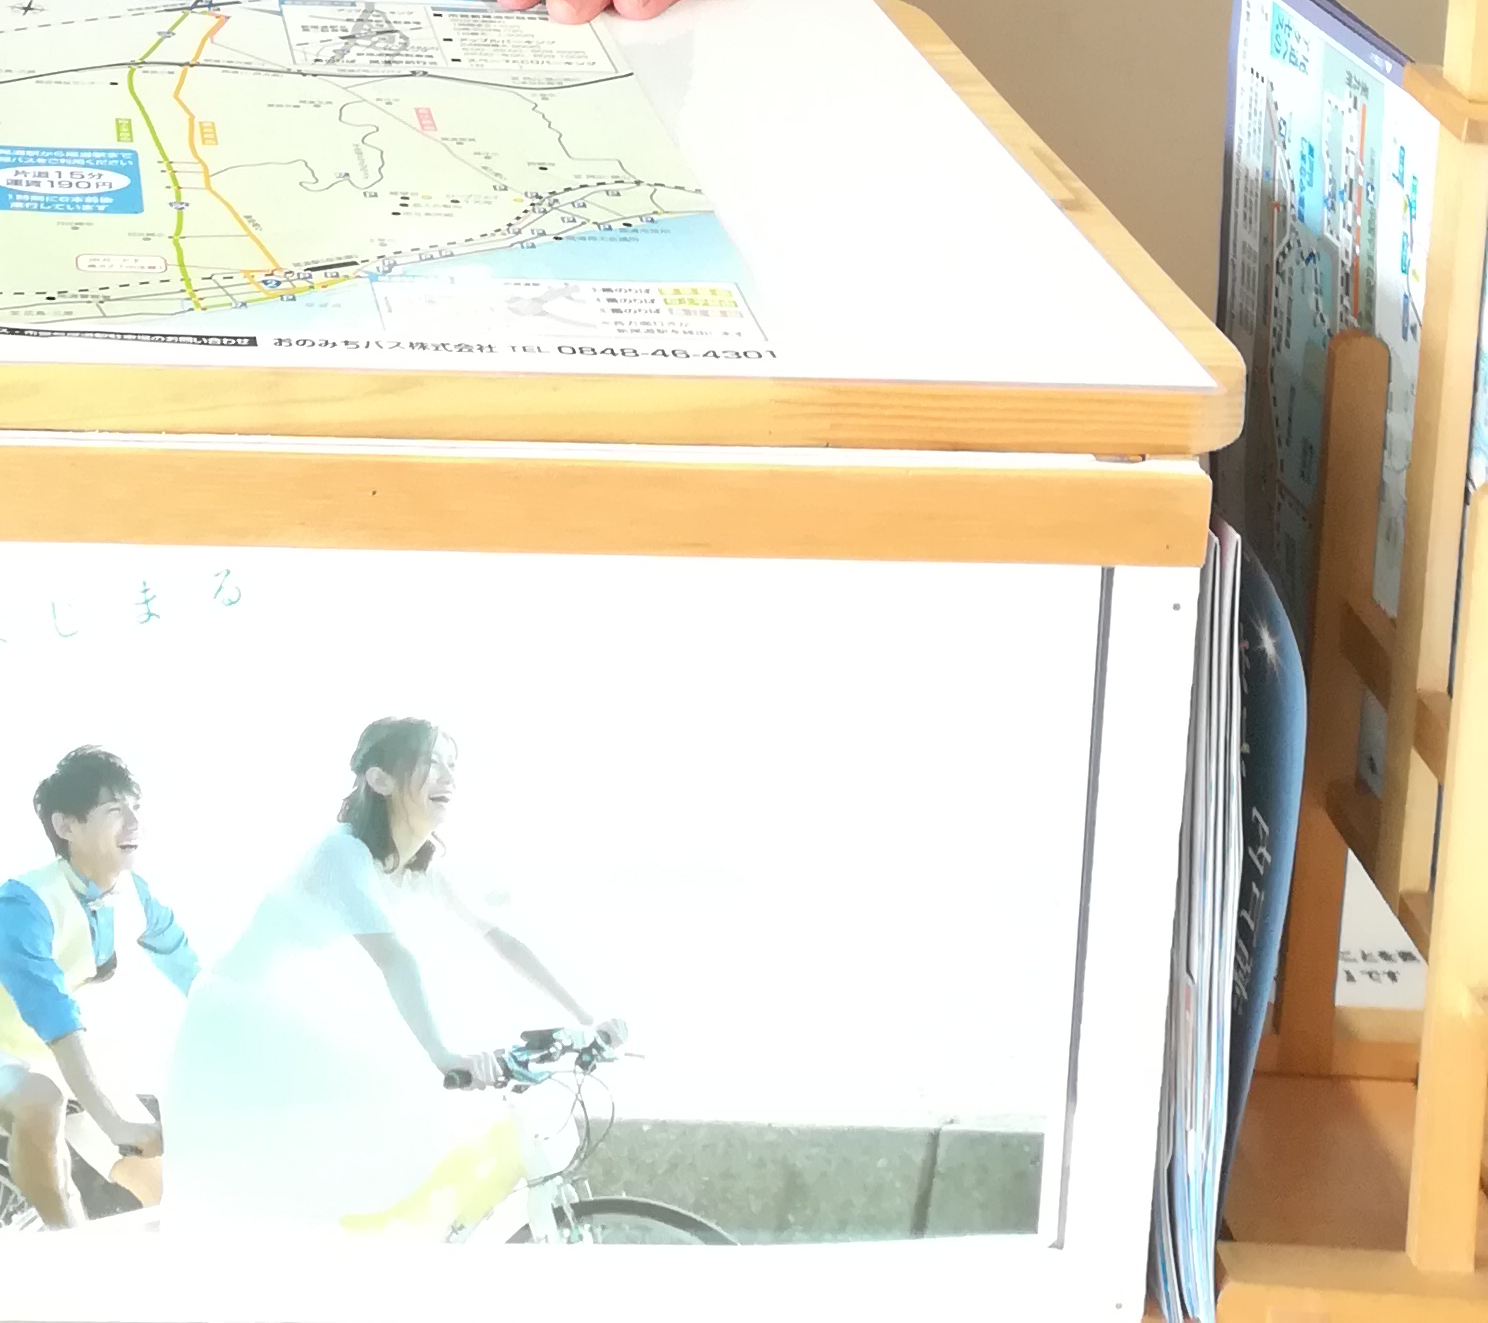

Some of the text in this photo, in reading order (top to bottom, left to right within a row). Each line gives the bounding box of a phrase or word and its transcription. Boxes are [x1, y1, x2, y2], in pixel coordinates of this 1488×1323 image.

[13, 169, 104, 180] 片道15分
[6, 178, 114, 190] 運賃190円
[272, 335, 779, 361] おのみちバス株式会社 TEL 0848-46-4301
